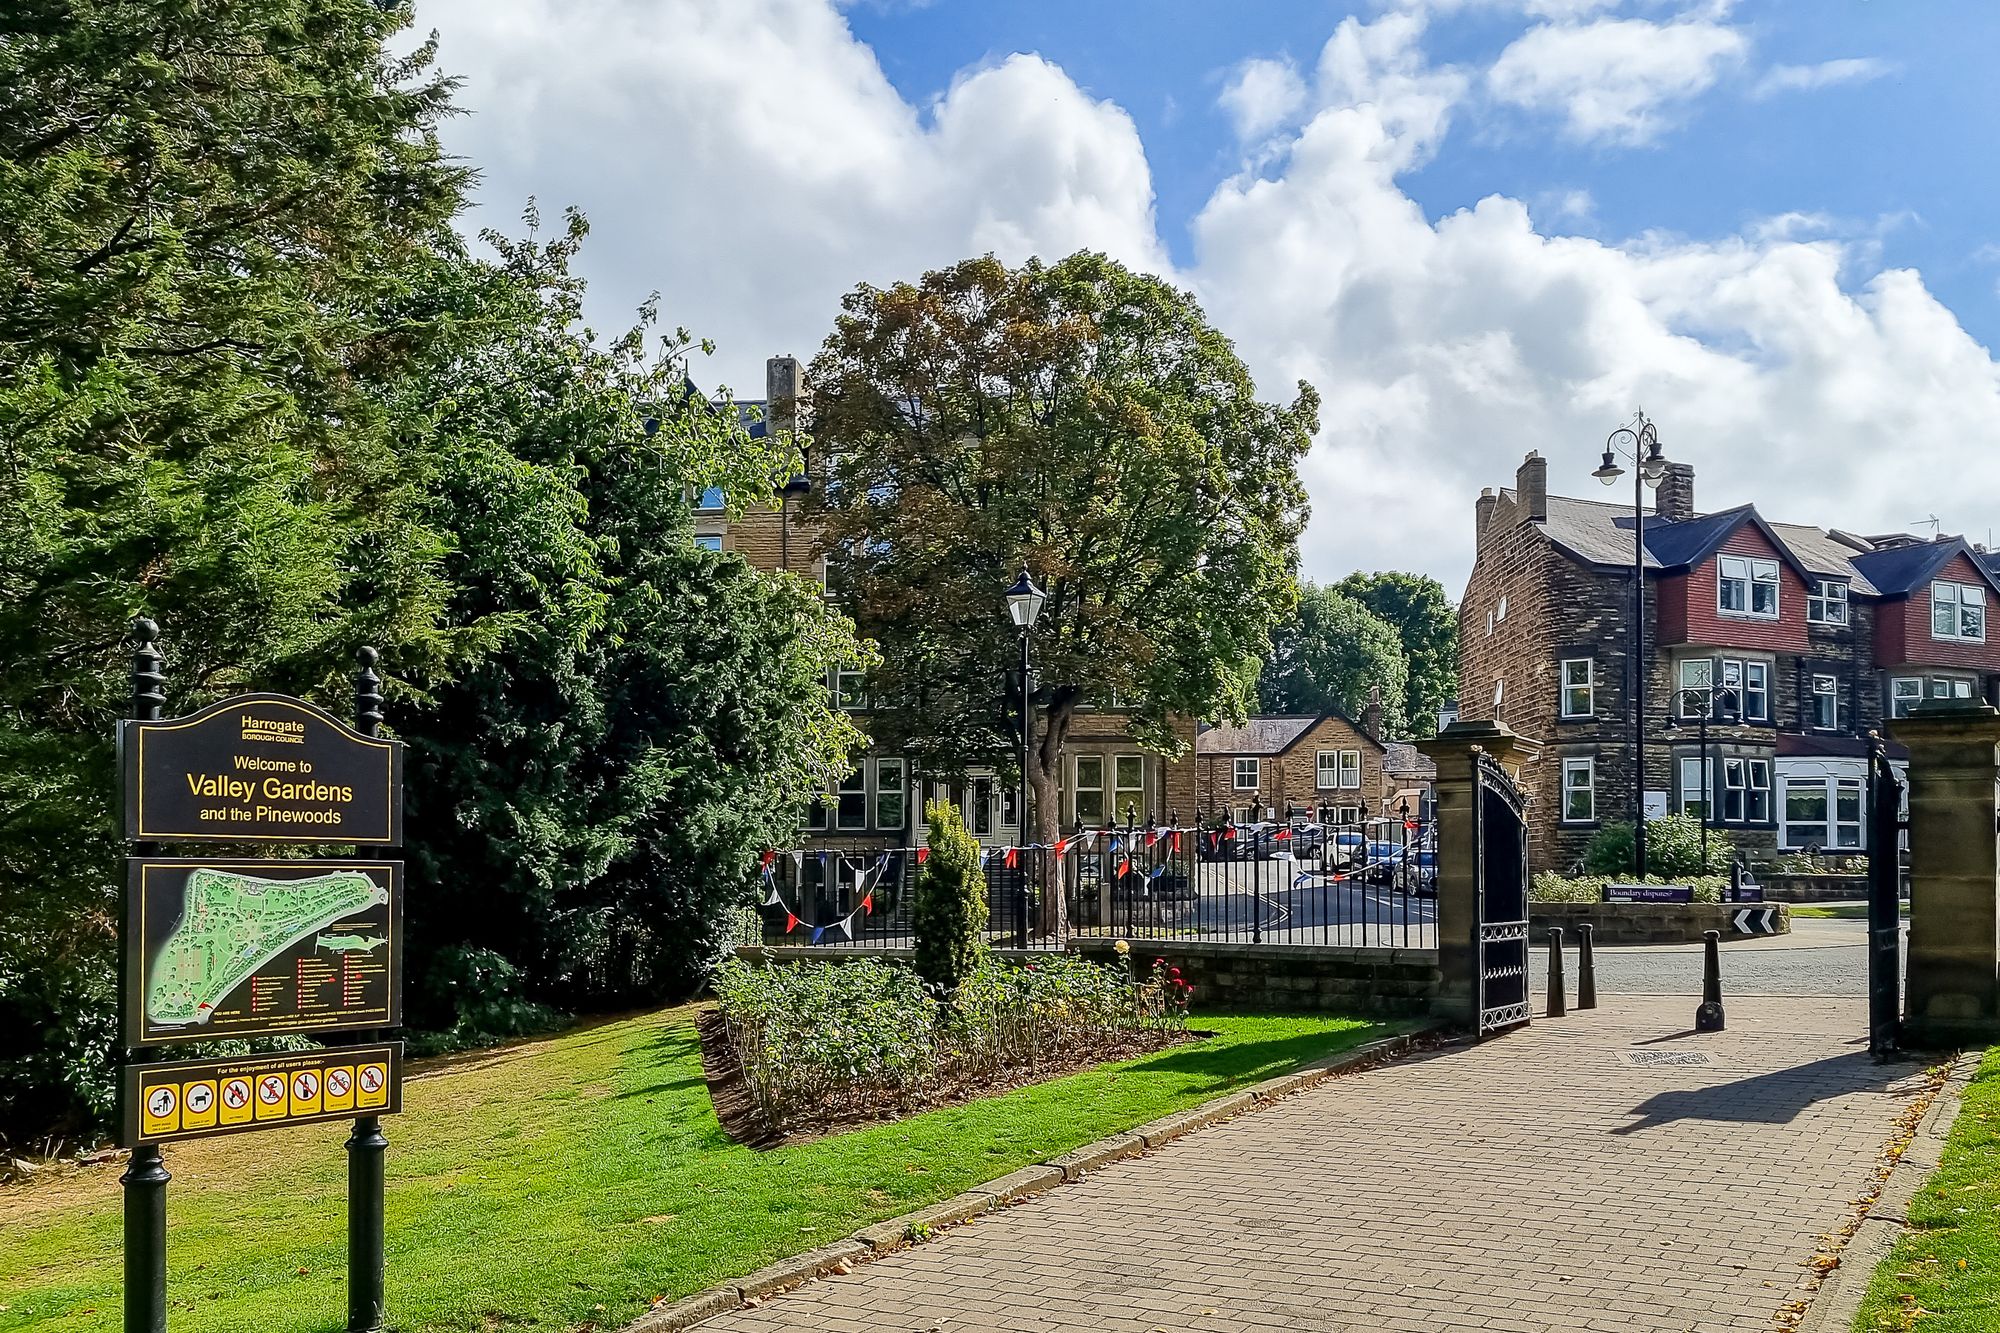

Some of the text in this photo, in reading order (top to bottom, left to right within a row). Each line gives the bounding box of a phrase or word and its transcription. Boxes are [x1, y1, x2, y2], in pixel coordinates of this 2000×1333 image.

[241, 715, 305, 733] Harrogate
[241, 733, 305, 744] BOROUGH COUNCIL
[234, 755, 312, 773] Welcome to
[187, 773, 353, 803] Valley Gardens
[200, 805, 342, 824] and the Pinewoods
[1610, 889, 1641, 899] Boundary
[239, 1064, 270, 1073] enjoyment
